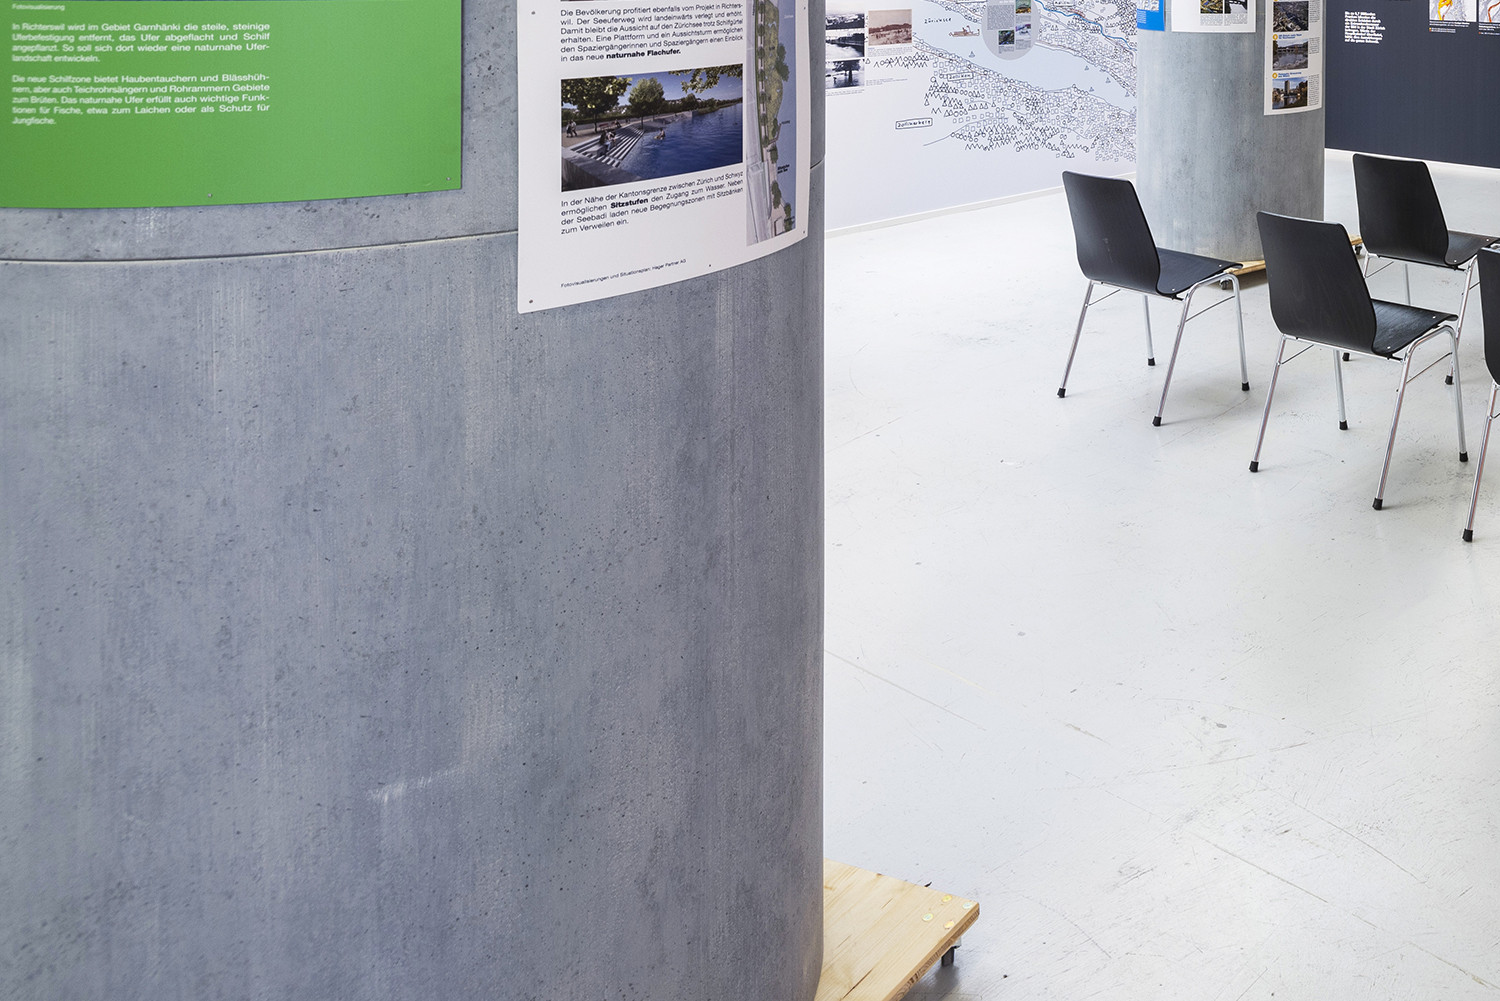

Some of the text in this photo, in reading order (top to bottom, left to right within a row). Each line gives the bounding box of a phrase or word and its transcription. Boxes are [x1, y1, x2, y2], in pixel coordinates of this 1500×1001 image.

[575, 8, 621, 16] Bevölkerung
[622, 6, 651, 15] profitiert
[101, 22, 270, 32] Gebiet Garnhänki die steile, steinige
[78, 31, 270, 43] entfernt, das Ufer abgeflacht und Schilf
[605, 50, 645, 59] naturnahe
[646, 48, 680, 56] Flachufer.
[121, 72, 270, 82] Haubentauchern und Blässhüh-
[134, 102, 270, 113] Laichen oder als Schutz für
[584, 195, 604, 203] Nähe
[618, 186, 667, 198] Kantonsgrenze
[668, 181, 695, 190] zwischen
[560, 204, 607, 216] ermöglichen
[610, 198, 648, 208] Sitzstufen
[665, 190, 689, 200] Zugang
[704, 183, 727, 192] Wasser.
[579, 221, 614, 231] Verweilen
